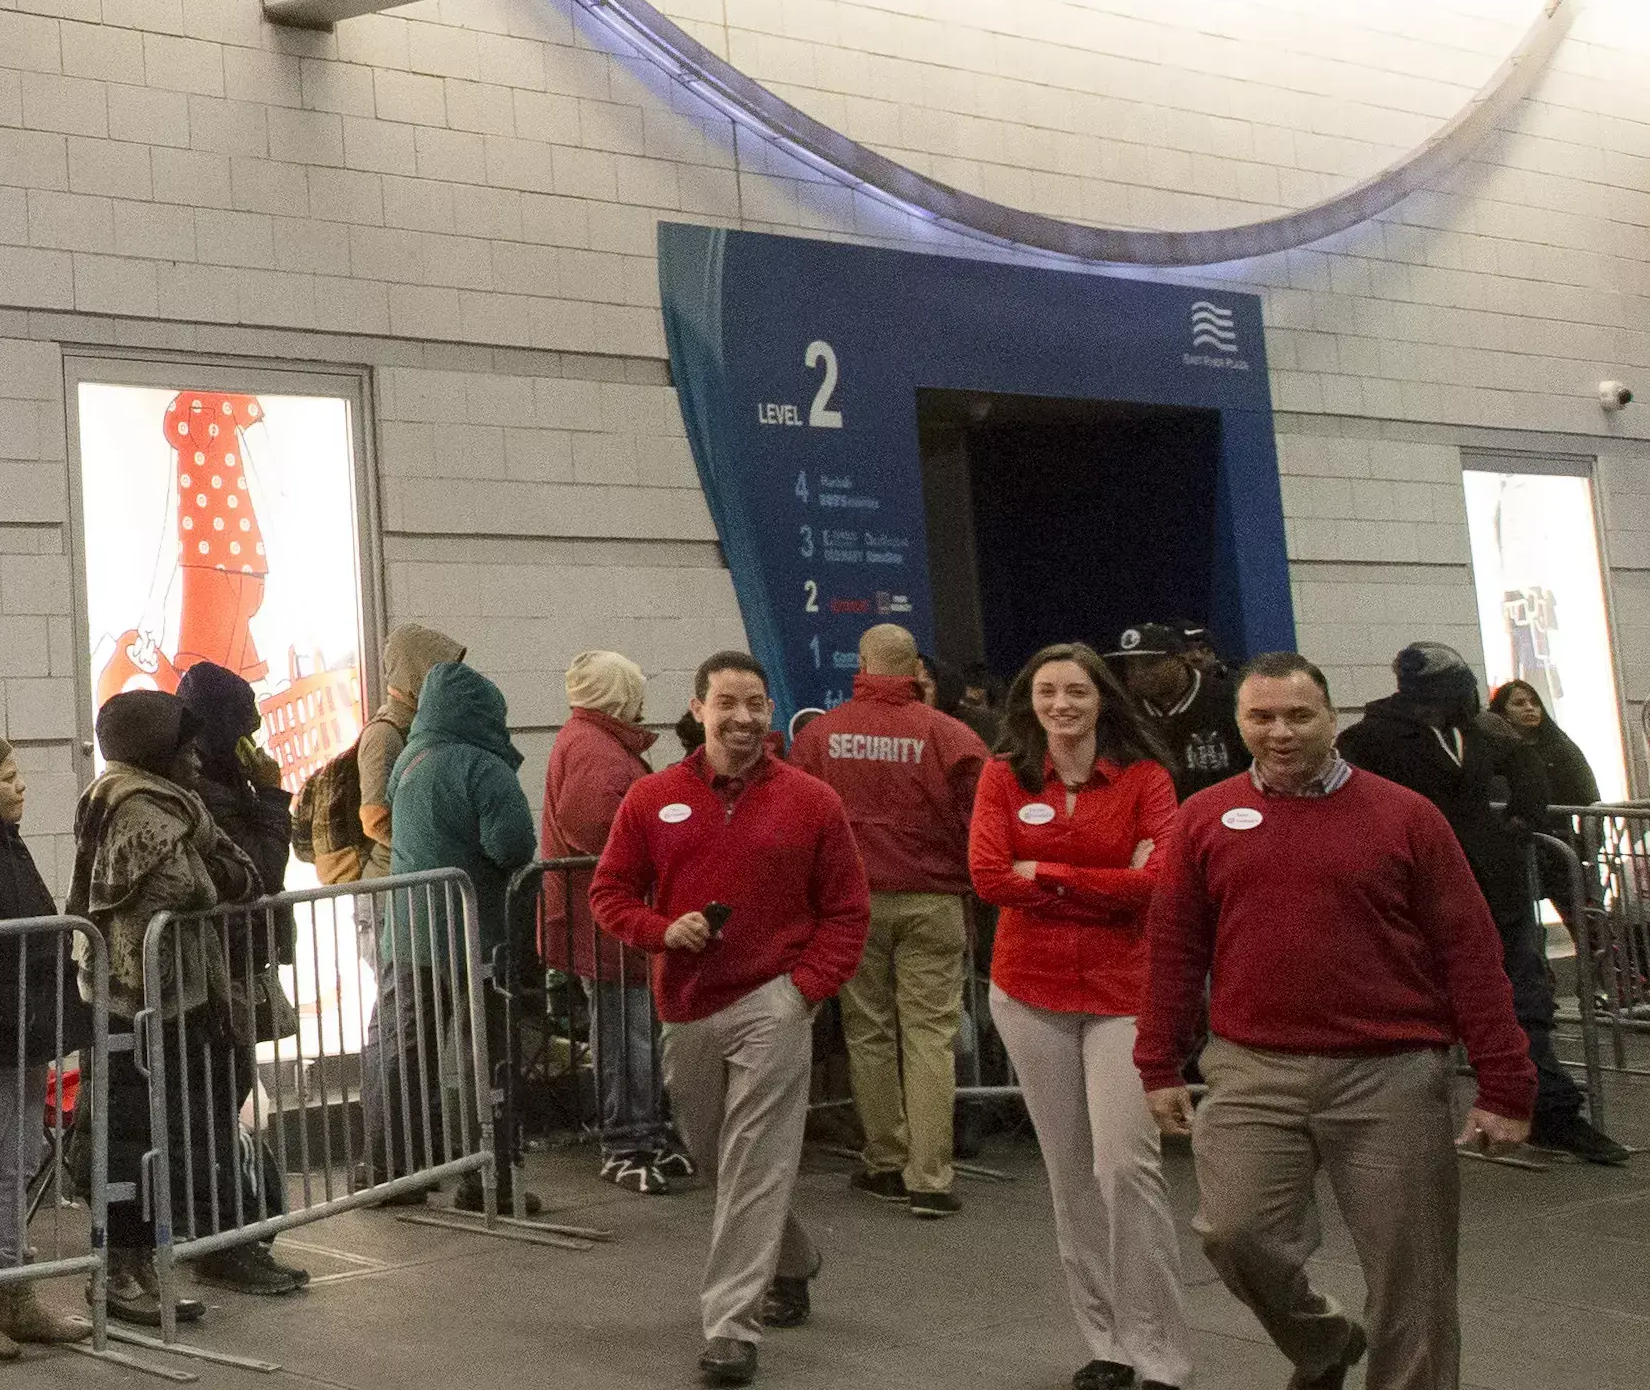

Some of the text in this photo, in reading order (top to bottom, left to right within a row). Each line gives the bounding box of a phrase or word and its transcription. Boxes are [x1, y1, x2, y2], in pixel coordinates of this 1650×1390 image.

[758, 340, 843, 428] LEVEL 2
[799, 524, 814, 557] 3
[804, 580, 819, 612] 2
[809, 636, 820, 669] 1
[828, 732, 925, 764] SECURITY
